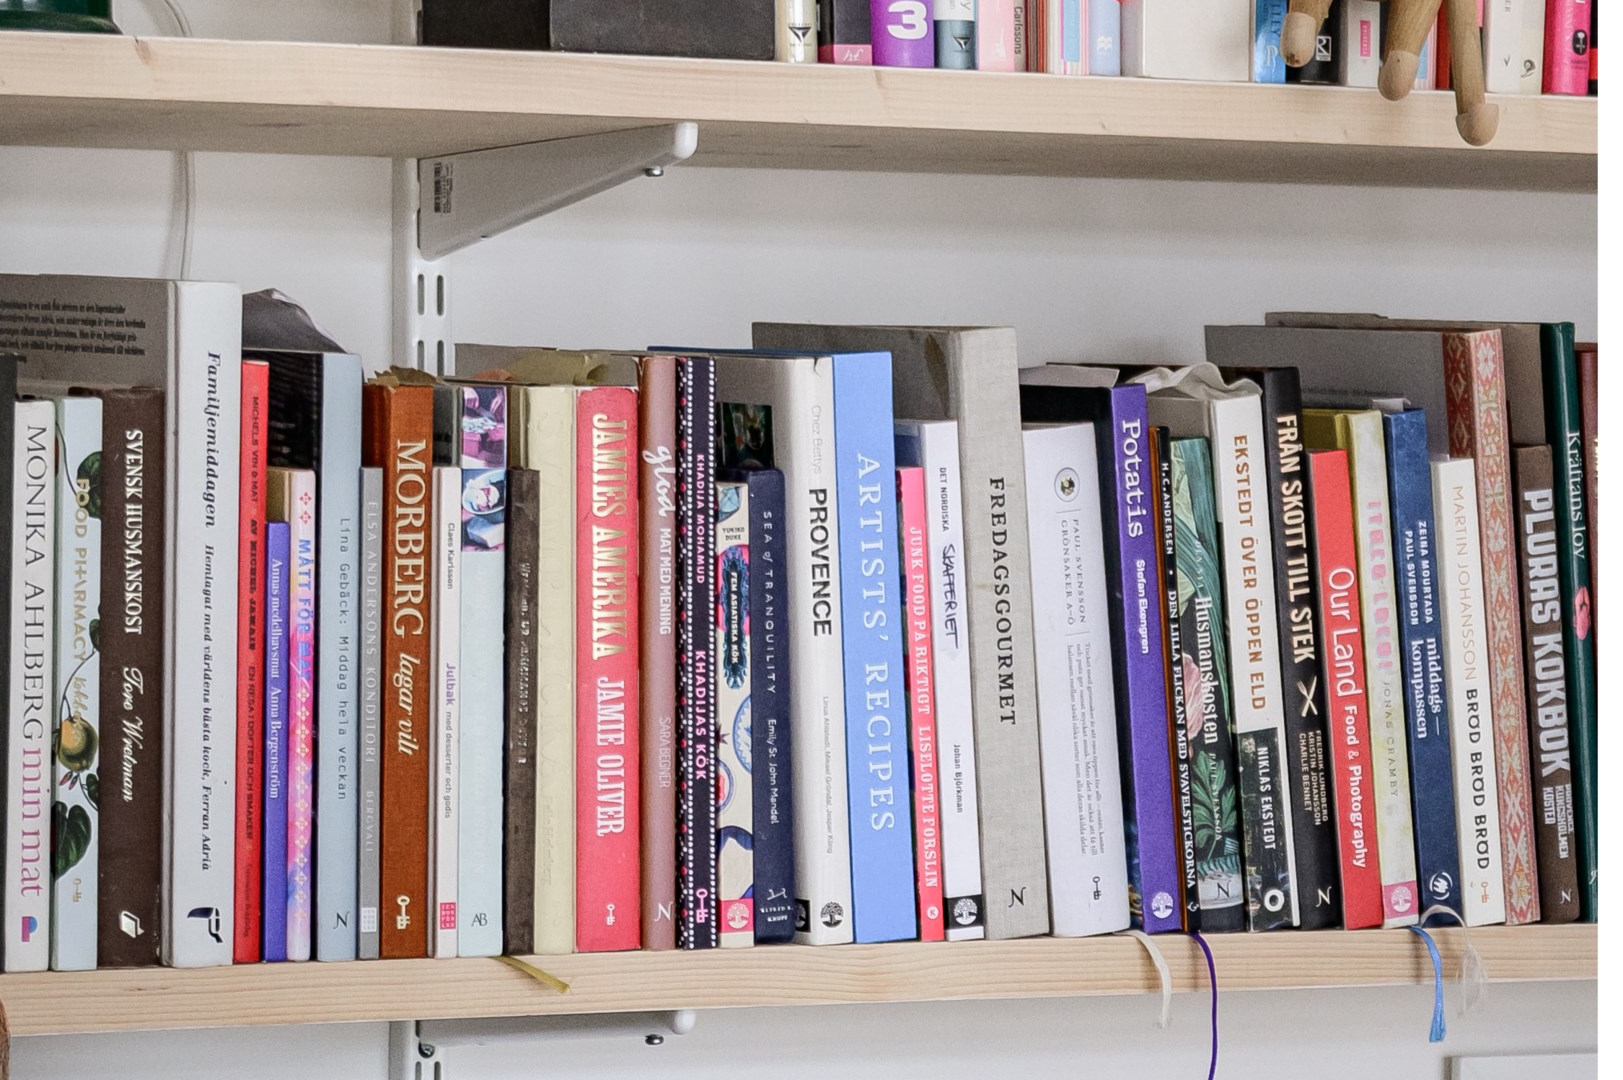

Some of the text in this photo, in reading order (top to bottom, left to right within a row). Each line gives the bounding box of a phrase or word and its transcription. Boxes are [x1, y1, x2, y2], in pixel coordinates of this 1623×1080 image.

[887, 0, 928, 40] 3
[1013, 6, 1023, 55] Carlssons
[75, 478, 90, 539] FOOD
[366, 502, 378, 541] ELSA
[642, 445, 677, 635] glöd MAT MED MENING
[762, 511, 774, 544] SEA
[909, 526, 923, 570] JUNK
[1122, 419, 1151, 654] Potatis Stefan Ekengren
[1276, 414, 1315, 664] FRÅN SKOTT TILL STEK
[1566, 430, 1587, 560] Kräftans lov
[121, 428, 145, 802] SVENSK HUSMANSKOST Tore Wretman
[201, 351, 221, 871] Familjemiddagen Hemlagat med världens bästa kock, Ferran Adrià
[392, 439, 427, 757] MORBERG lagar vilt
[591, 412, 629, 837] JAMIES AMERIKA JAMIE OLIVER
[808, 488, 833, 637] PROVENCE
[911, 574, 925, 616] FOOD
[989, 476, 1017, 726] FREDAGSGOURMET
[1233, 435, 1266, 710] EKSTEDT ÖVER ÖPPEN ELD
[1404, 530, 1420, 625] PAUL SVENSSON
[1418, 520, 1434, 624] ZEINA MOURTADA
[20, 424, 51, 897] MONIKA AHLBERG min mat
[267, 558, 283, 798] Annas medelhavsmat Anna Bergenström
[336, 517, 351, 801] Lina Gebäck: Middag hela veckan
[763, 569, 777, 693] TRANQUILITY
[857, 453, 895, 832] ARTISTS' RECIPES
[915, 646, 931, 714] RIKTIGT
[1194, 596, 1220, 745] Husmanskosten
[1409, 638, 1430, 739] kompassen
[1424, 637, 1443, 713] middags
[1524, 487, 1571, 777] PLURAS KOKBOK
[364, 667, 377, 763] KONDITORI
[918, 725, 935, 814] LISELOTTE
[1329, 567, 1369, 869] Our Land Food & Photography
[1383, 682, 1399, 798] JONAS CRAMBY
[922, 817, 938, 888] FORSLIN
[1257, 747, 1276, 850] NIKLAS EKSTEDT
